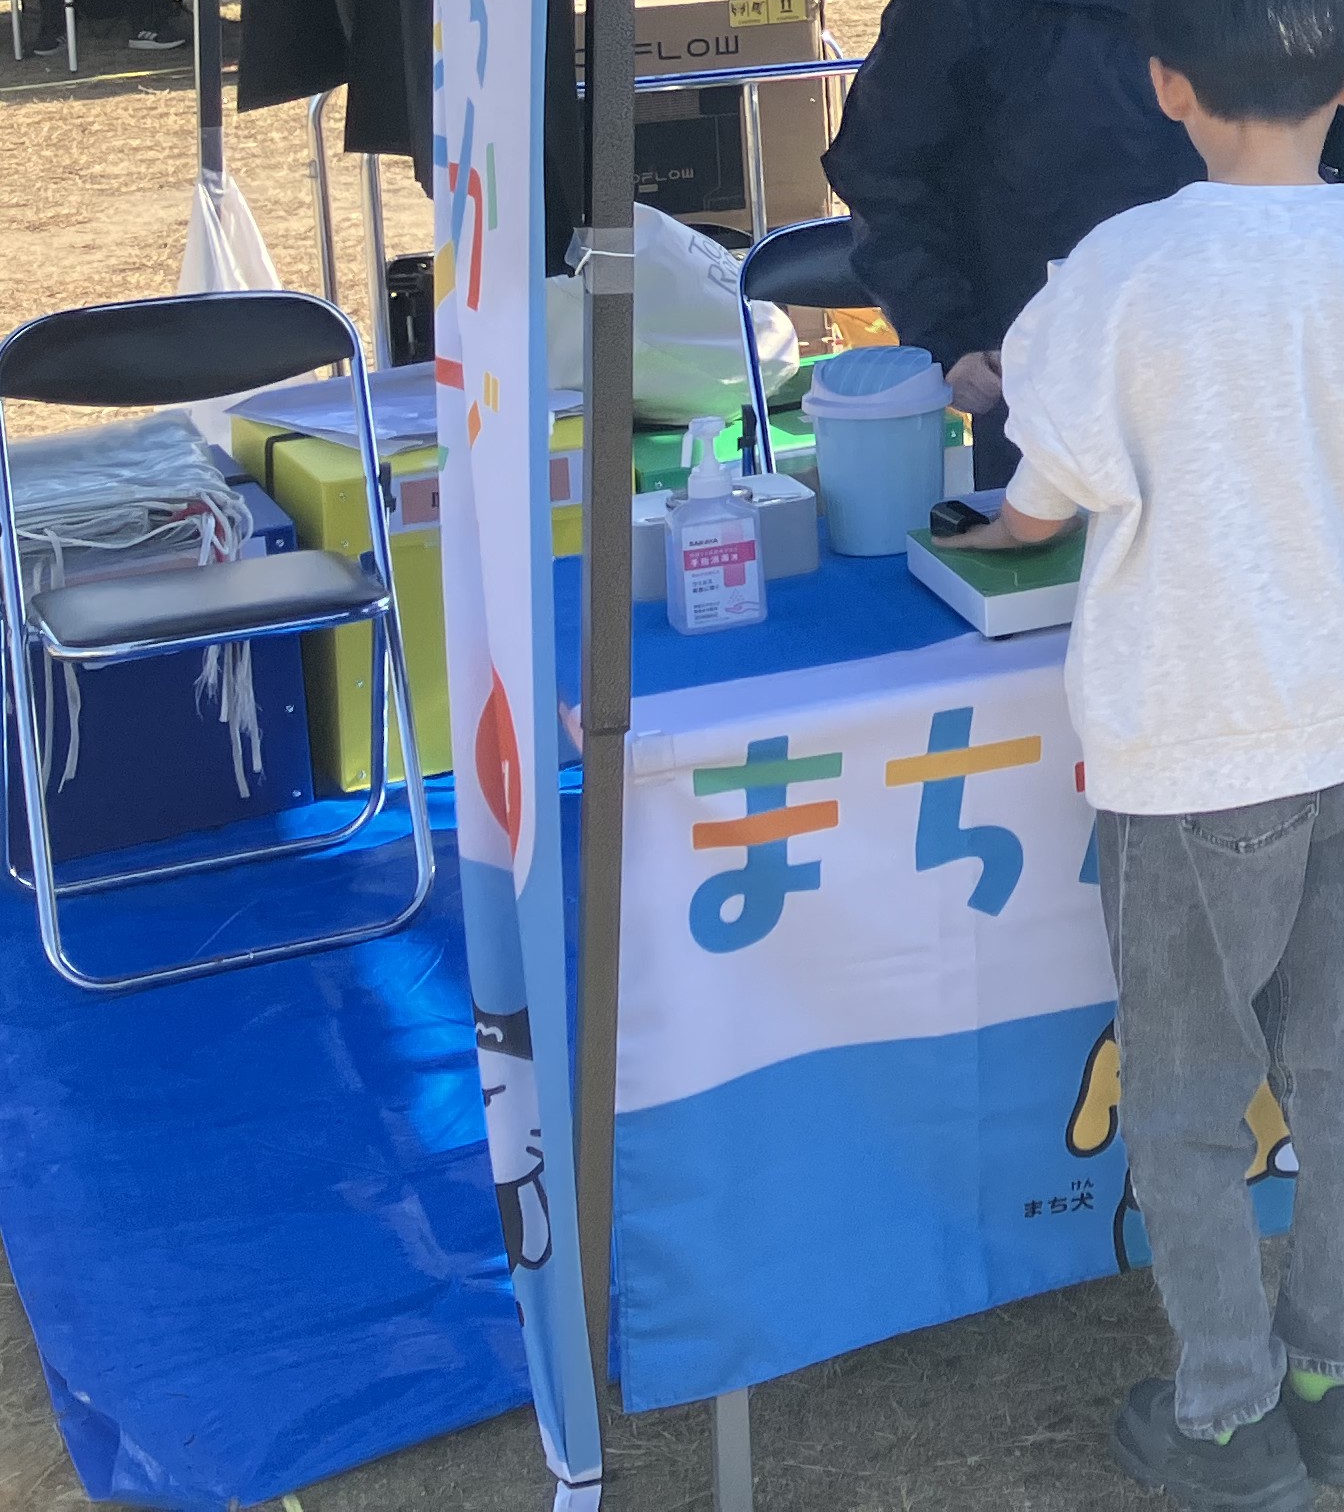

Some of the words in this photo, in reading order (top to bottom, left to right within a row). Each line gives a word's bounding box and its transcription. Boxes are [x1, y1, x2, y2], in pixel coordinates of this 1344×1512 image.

[689, 706, 1100, 954] まち
[1071, 1177, 1095, 1191] けん
[1024, 1191, 1095, 1219] まち犬
